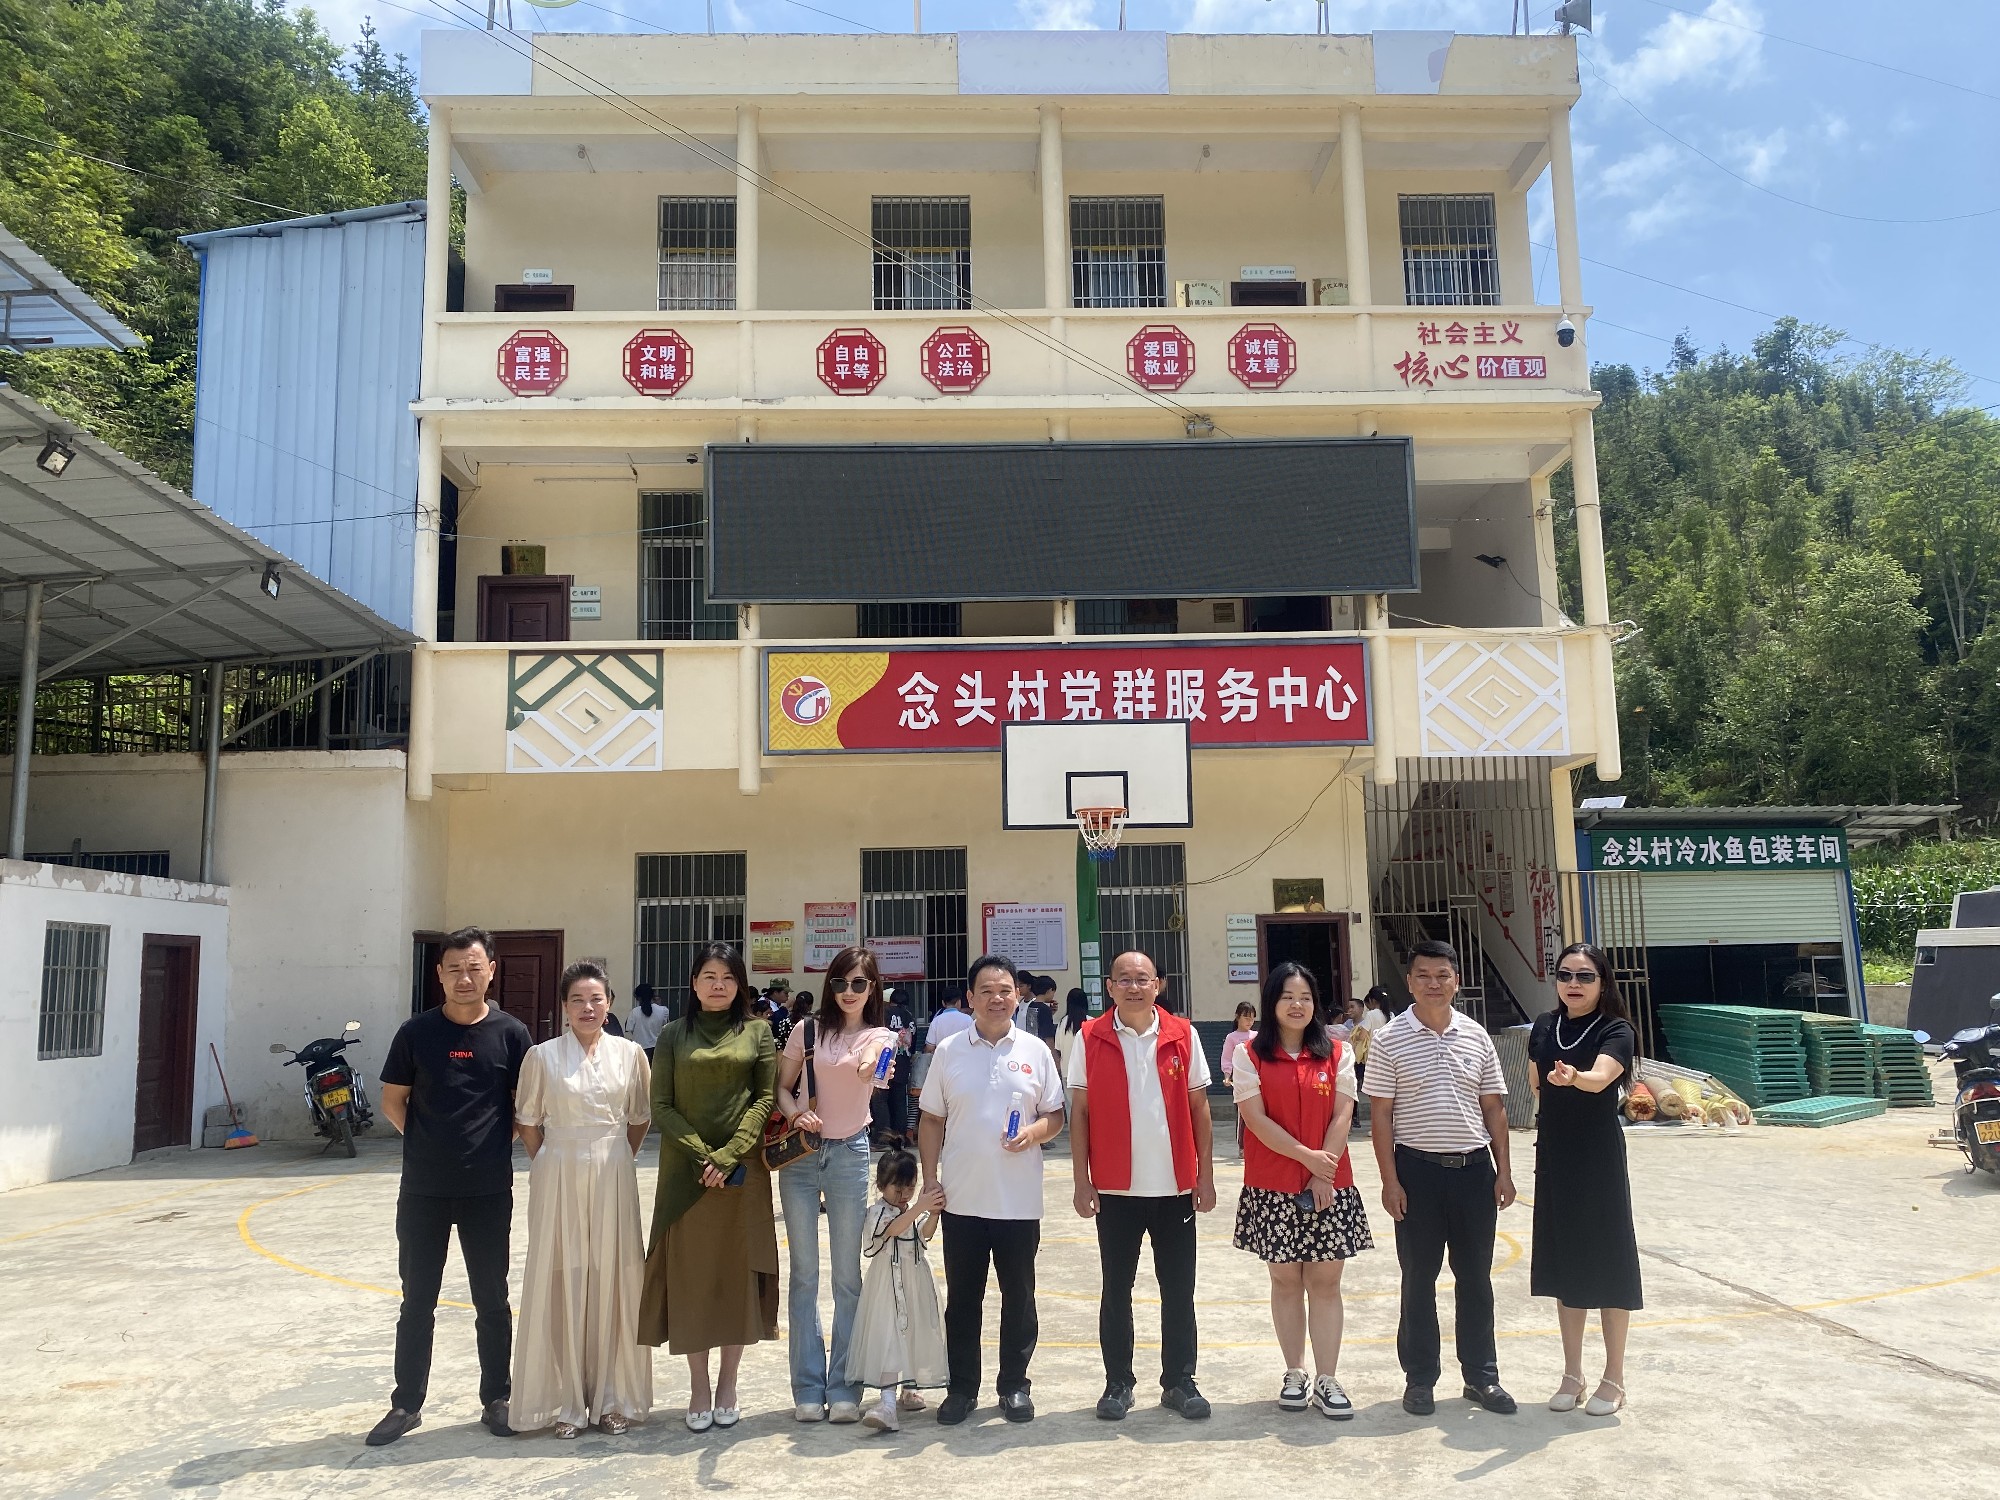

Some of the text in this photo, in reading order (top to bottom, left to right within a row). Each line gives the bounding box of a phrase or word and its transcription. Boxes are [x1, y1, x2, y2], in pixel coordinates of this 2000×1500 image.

[1417, 320, 1524, 346] 社会主义
[514, 346, 551, 363] 富强
[640, 345, 676, 362] 文明
[835, 344, 869, 362] 自由
[937, 342, 973, 359] 公正
[1143, 341, 1179, 358] 爱国
[1244, 338, 1280, 356] 诚信
[514, 364, 551, 381] 民主
[640, 363, 677, 380] 和谐
[834, 363, 871, 380] 平等
[937, 360, 974, 377] 法治
[1143, 359, 1180, 376] 敬业
[1245, 357, 1281, 374] 友善
[1393, 350, 1546, 388] 核心 价值观
[896, 665, 1359, 730] 念头村党群服务中心
[1601, 834, 1842, 866] 念头村冷水鱼包装车间
